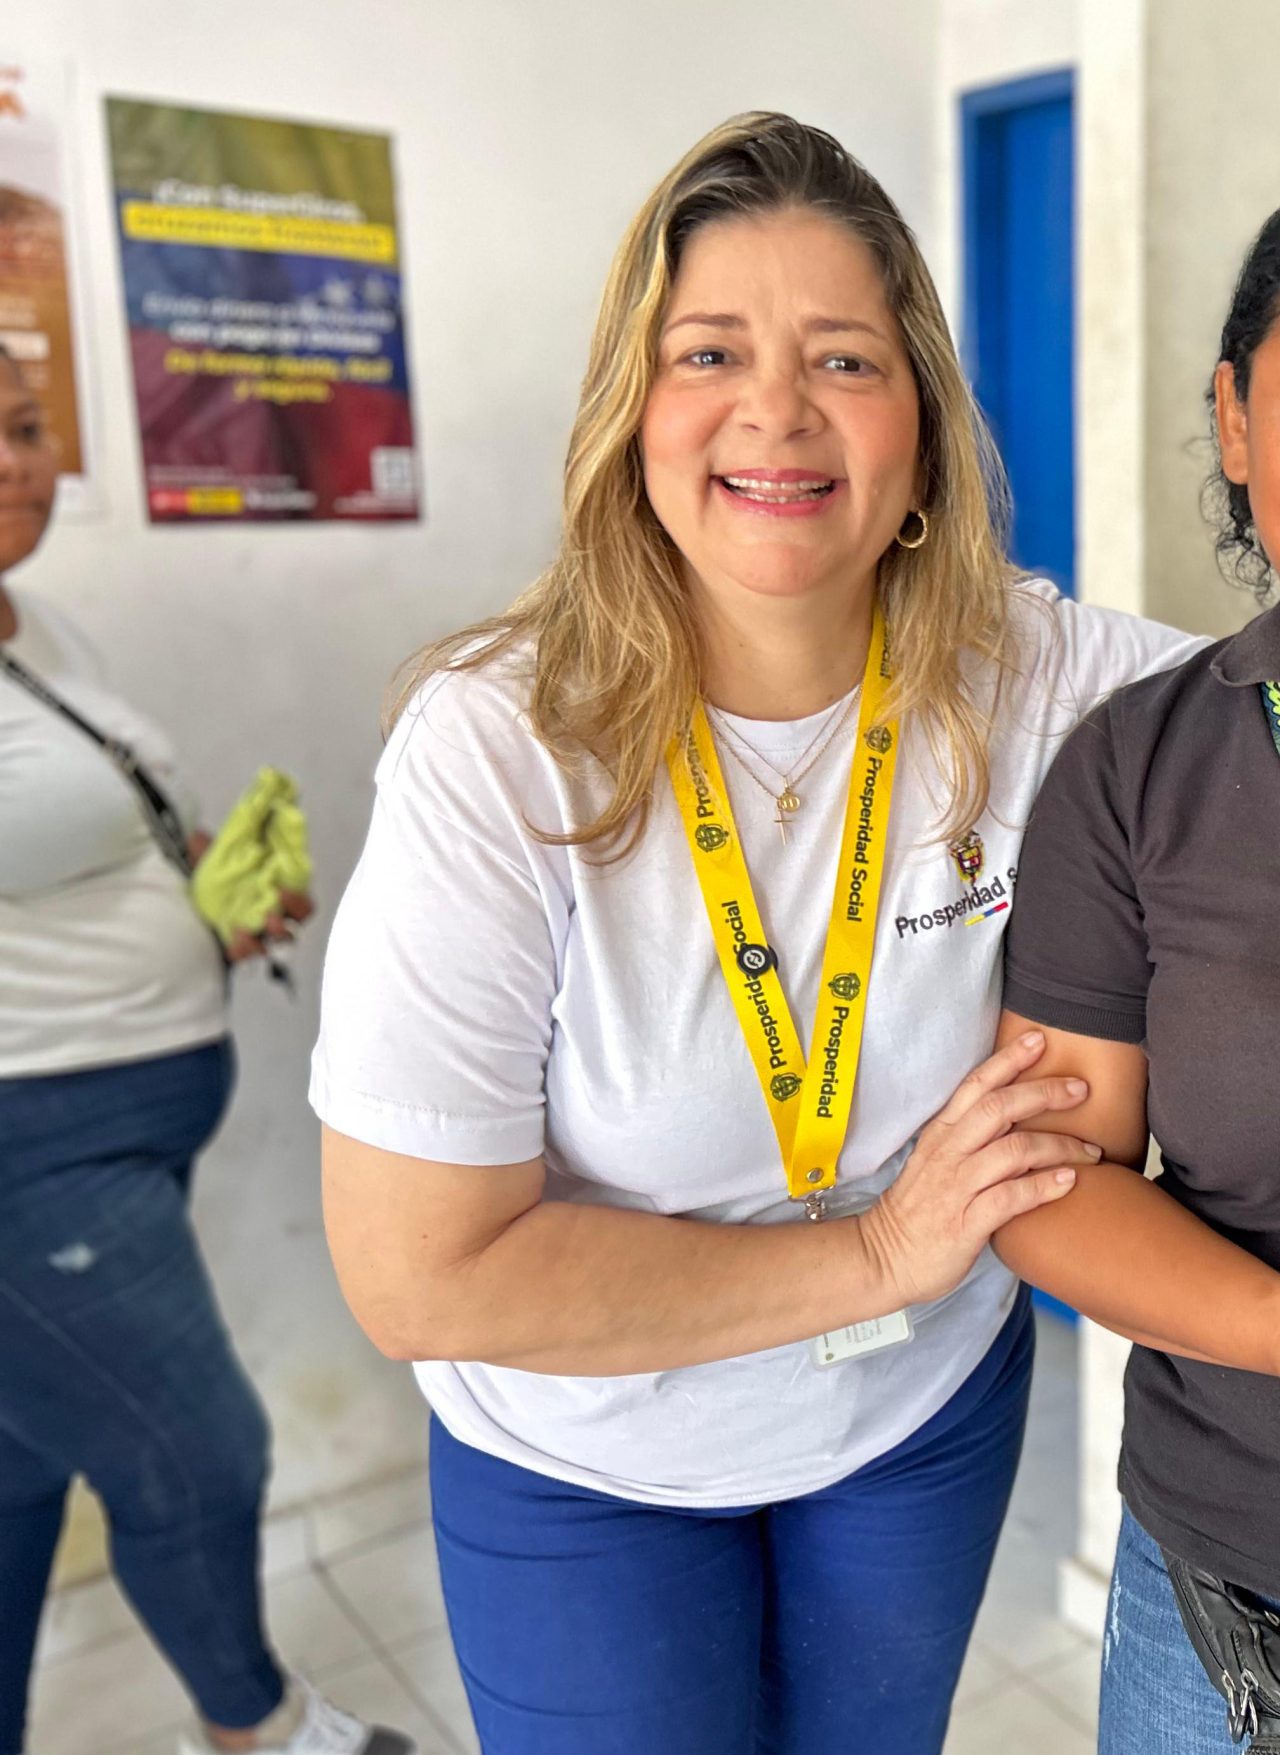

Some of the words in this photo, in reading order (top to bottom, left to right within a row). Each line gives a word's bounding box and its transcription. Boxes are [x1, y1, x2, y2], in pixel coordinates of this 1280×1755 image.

[853, 756, 882, 865] Prosperidad
[846, 866, 869, 922] Social
[894, 876, 1007, 939] Prosperidad
[744, 974, 787, 1070] Prosperida
[816, 1005, 850, 1119] Prosperidad
